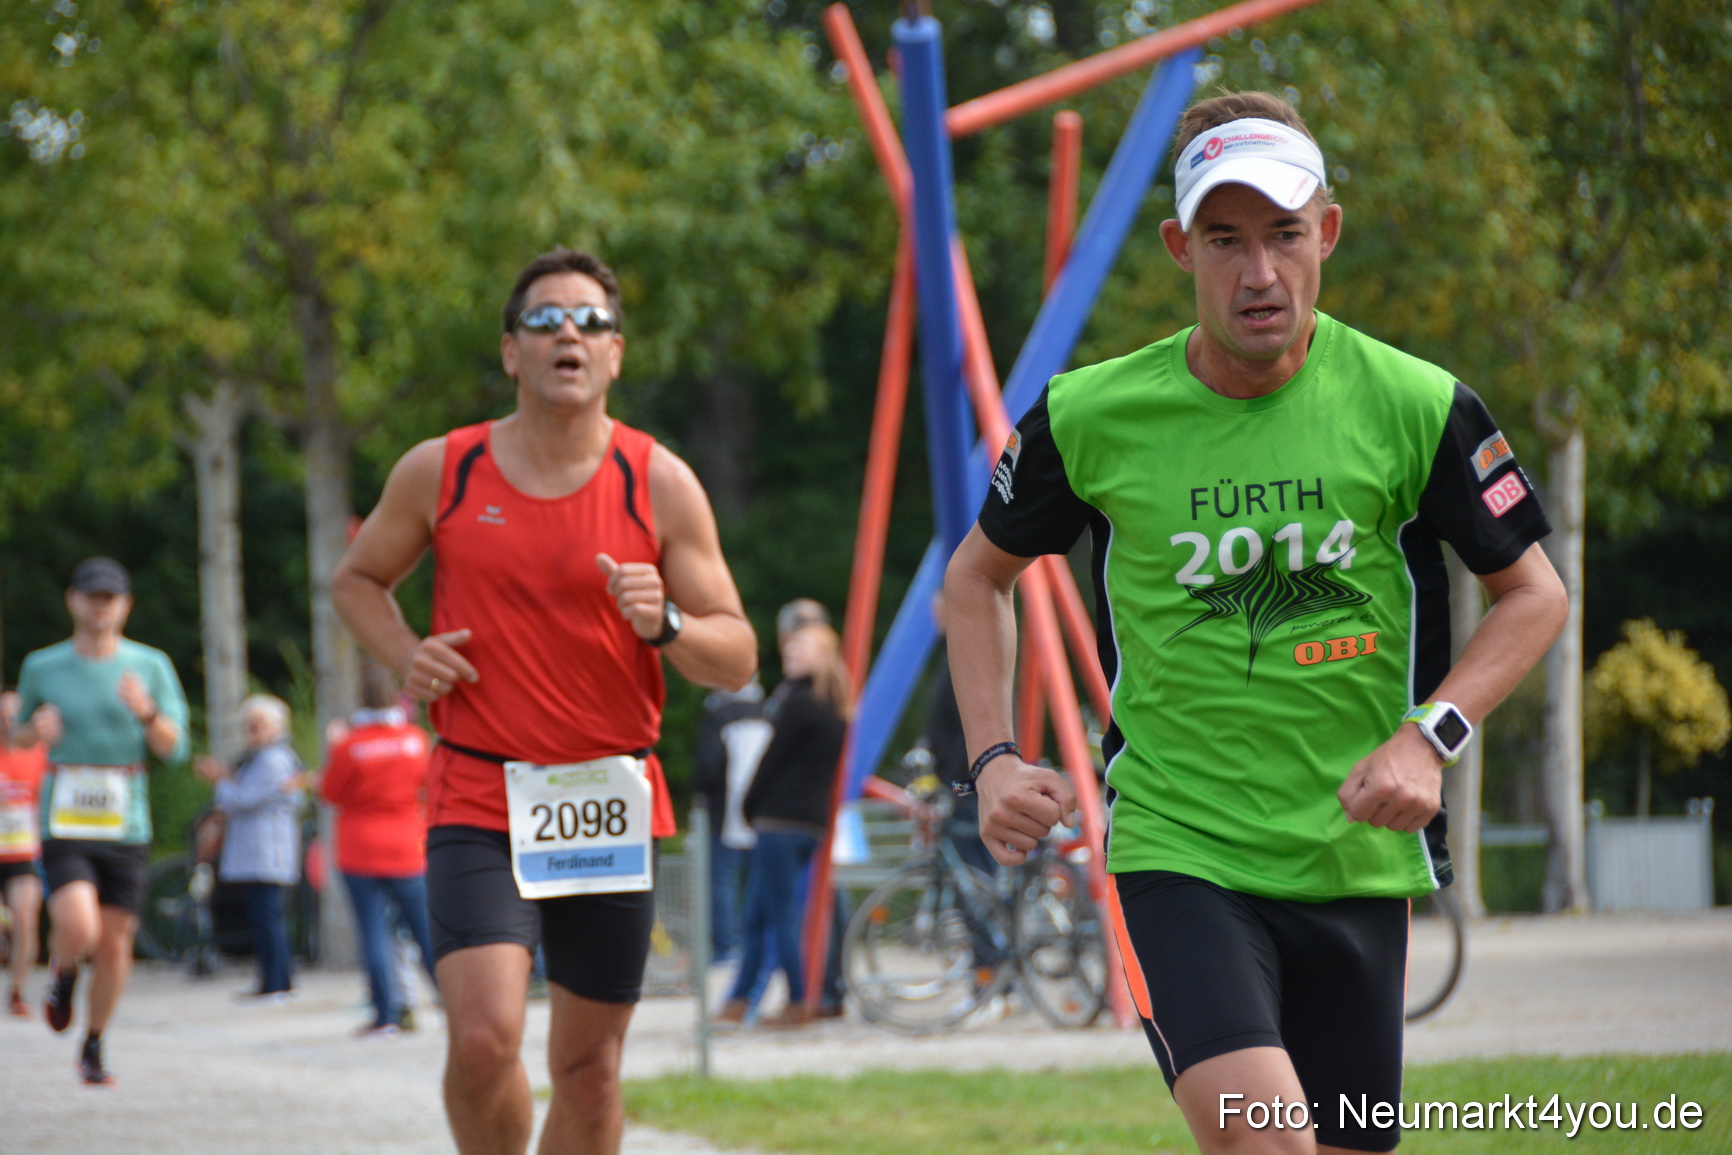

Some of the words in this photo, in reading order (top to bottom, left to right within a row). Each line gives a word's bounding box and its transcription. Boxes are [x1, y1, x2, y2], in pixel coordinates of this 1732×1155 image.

[1480, 437, 1511, 470] OB
[1190, 478, 1324, 520] FÜRTH
[1489, 479, 1521, 511] DB
[1170, 520, 1356, 585] 2014
[1289, 612, 1355, 635] powered
[1294, 632, 1379, 666] OBI
[531, 798, 627, 841] 2098
[547, 853, 615, 871] Ferdinand
